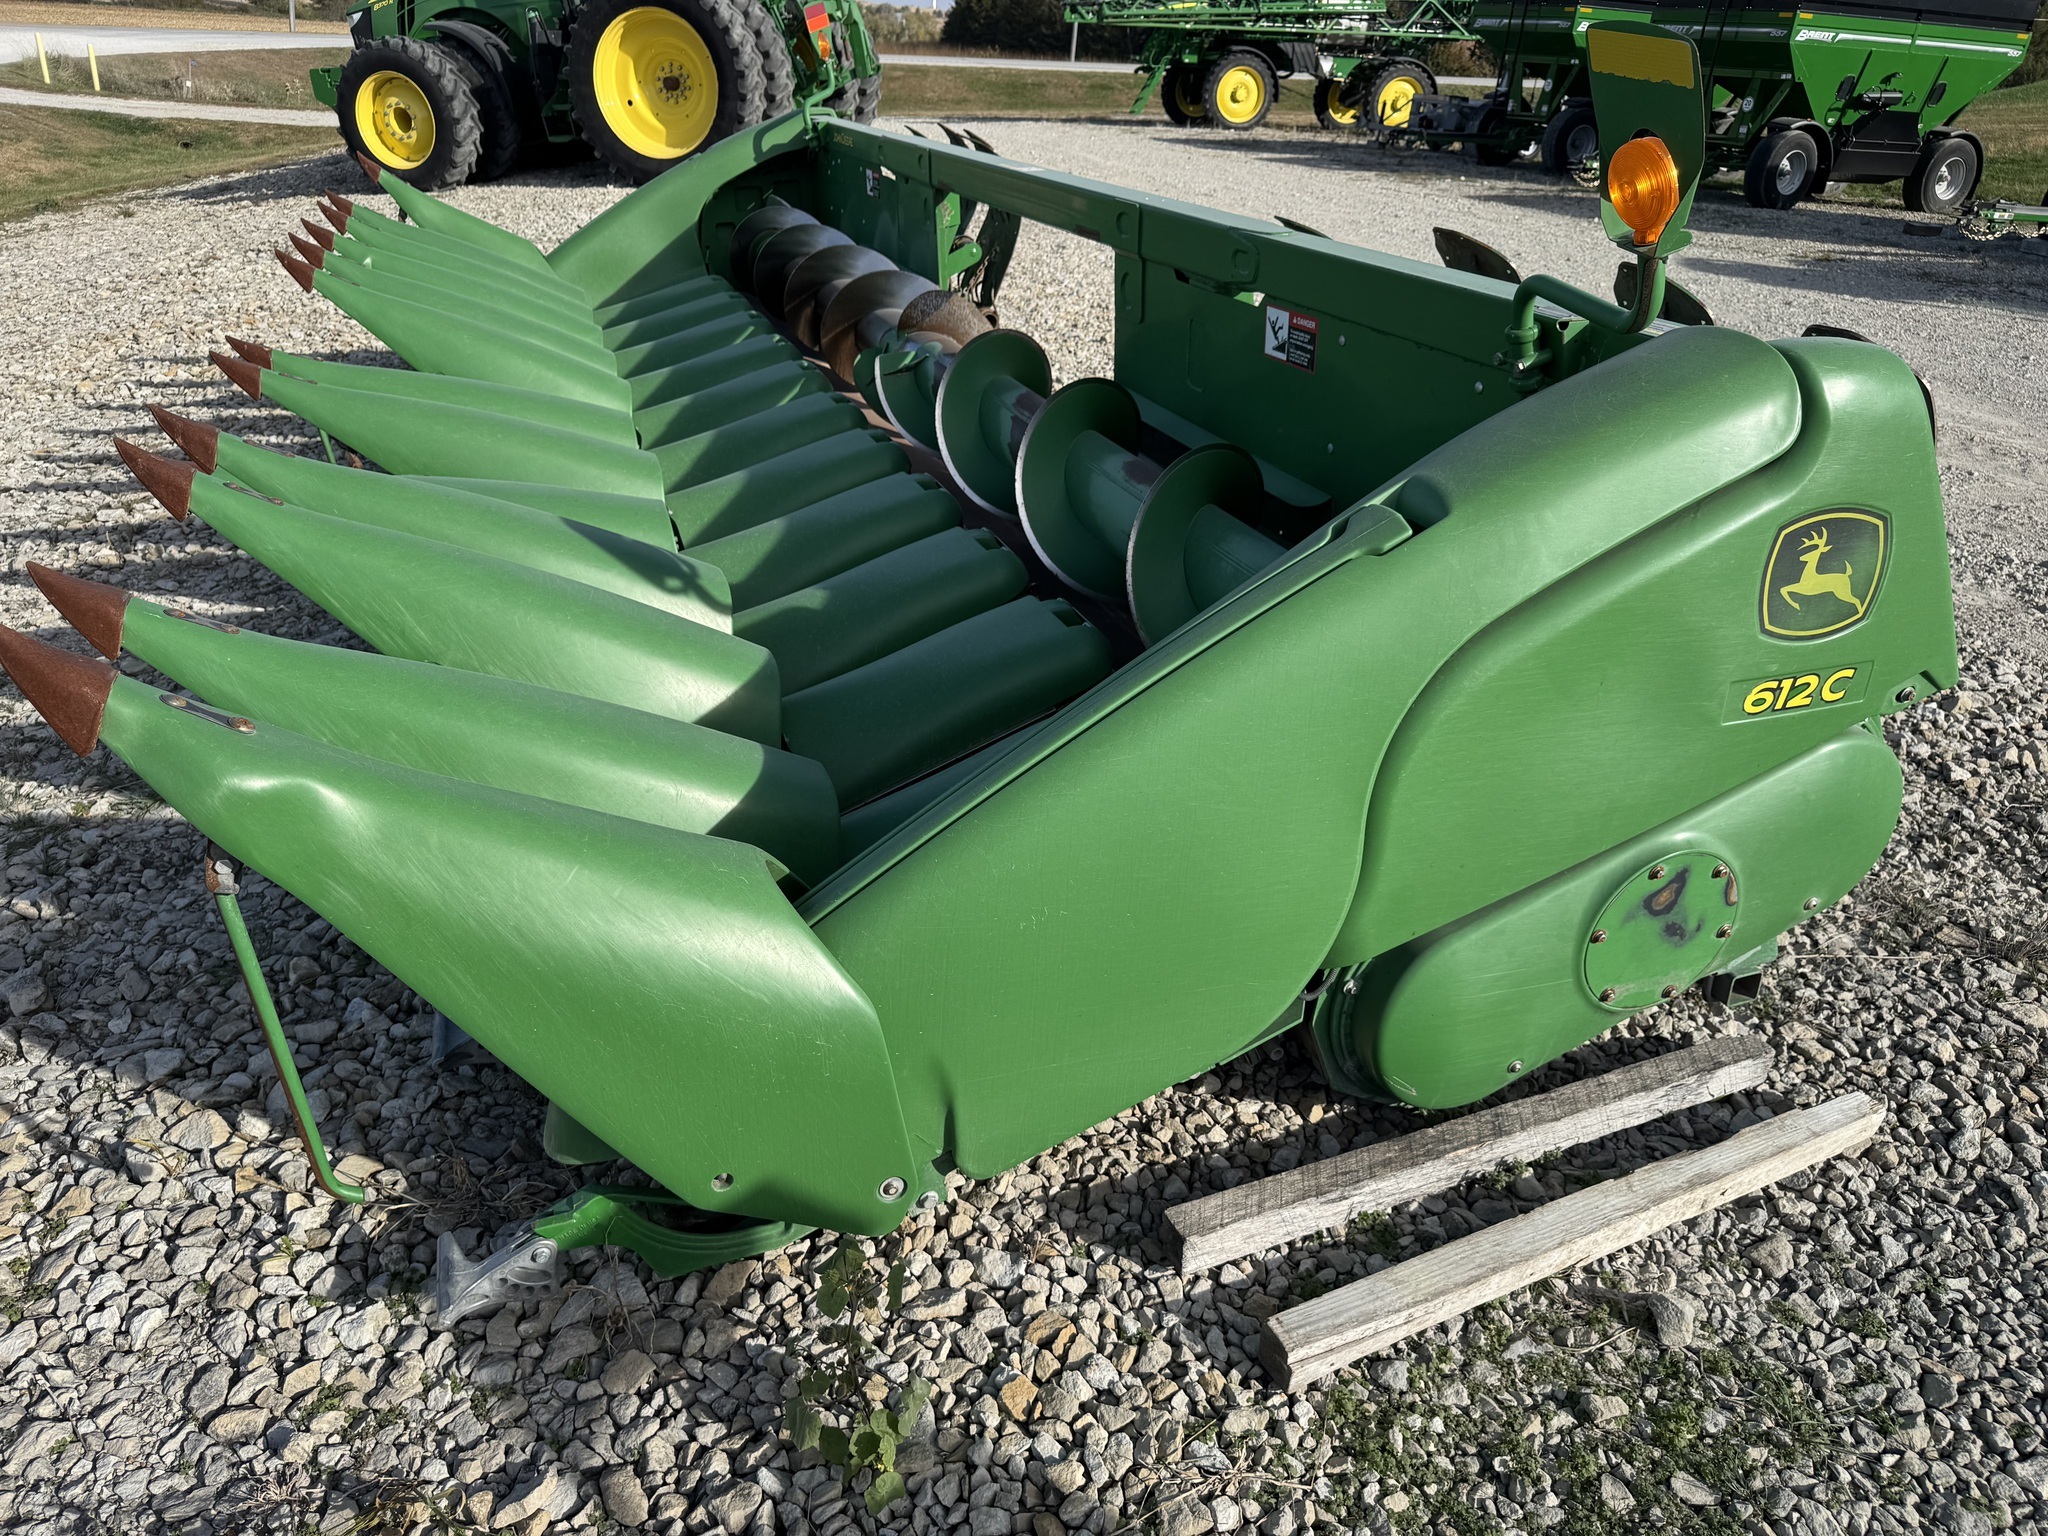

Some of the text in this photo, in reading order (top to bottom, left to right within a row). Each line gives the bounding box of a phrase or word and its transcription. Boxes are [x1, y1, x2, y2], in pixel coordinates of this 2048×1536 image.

[1658, 24, 1690, 34] RENT
[1795, 29, 1836, 43] BRENT
[1297, 317, 1315, 329] DANGER
[1743, 667, 1858, 715] 612C
